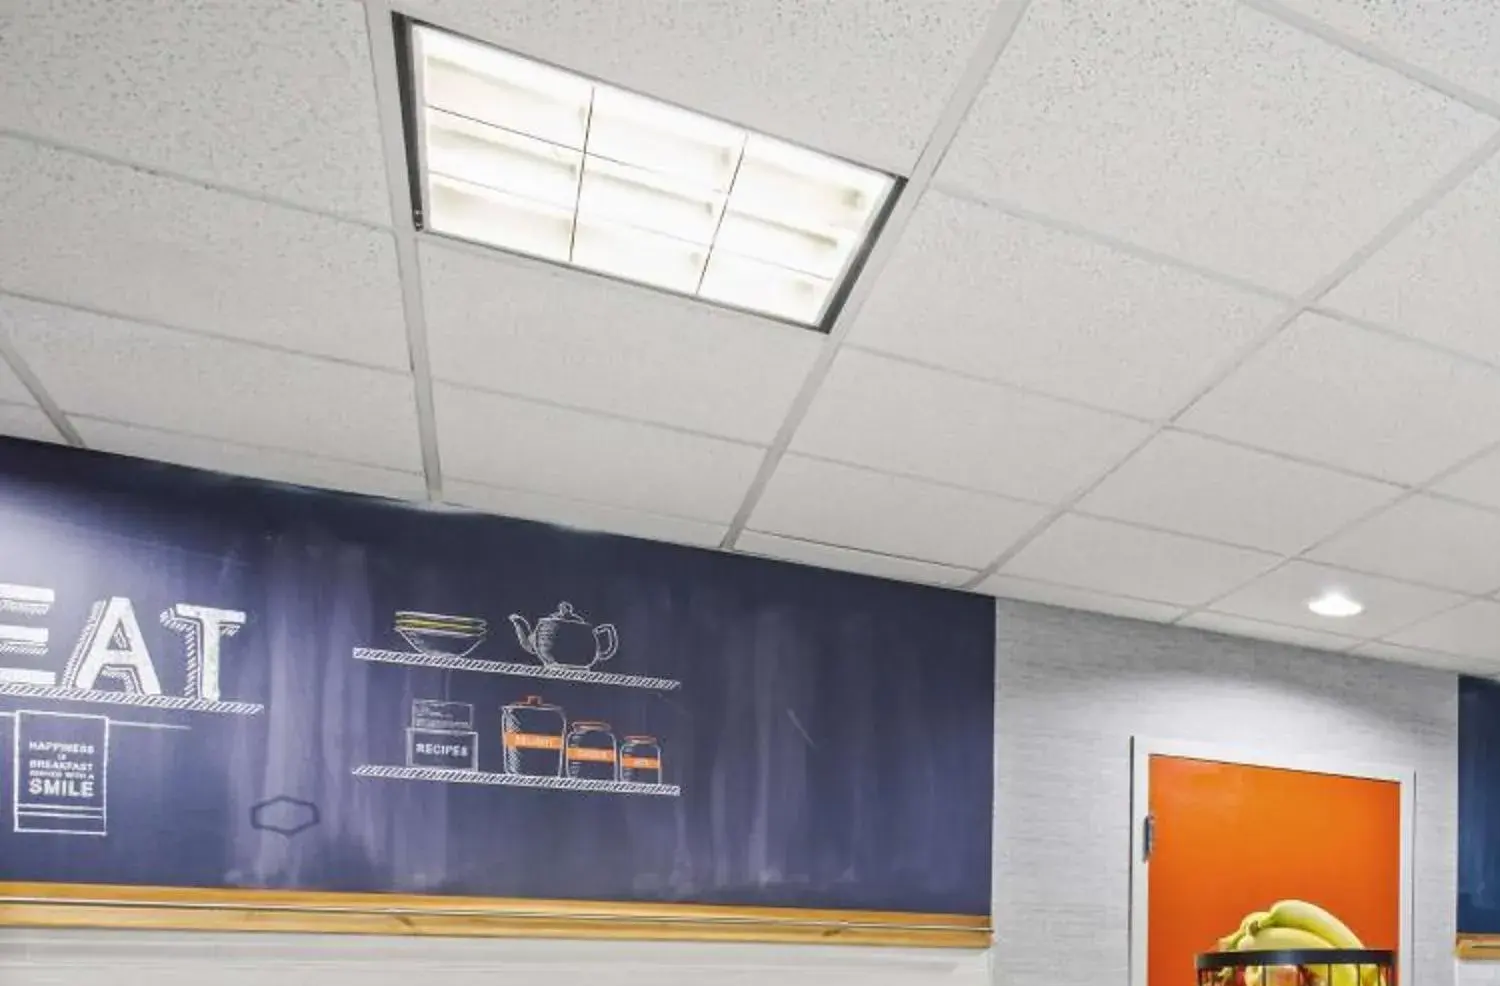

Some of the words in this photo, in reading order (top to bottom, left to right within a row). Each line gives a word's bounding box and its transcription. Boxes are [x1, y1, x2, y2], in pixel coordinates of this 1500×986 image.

[0, 583, 246, 700] EAT
[415, 744, 467, 757] RECIPES
[29, 779, 95, 797] SMILE
